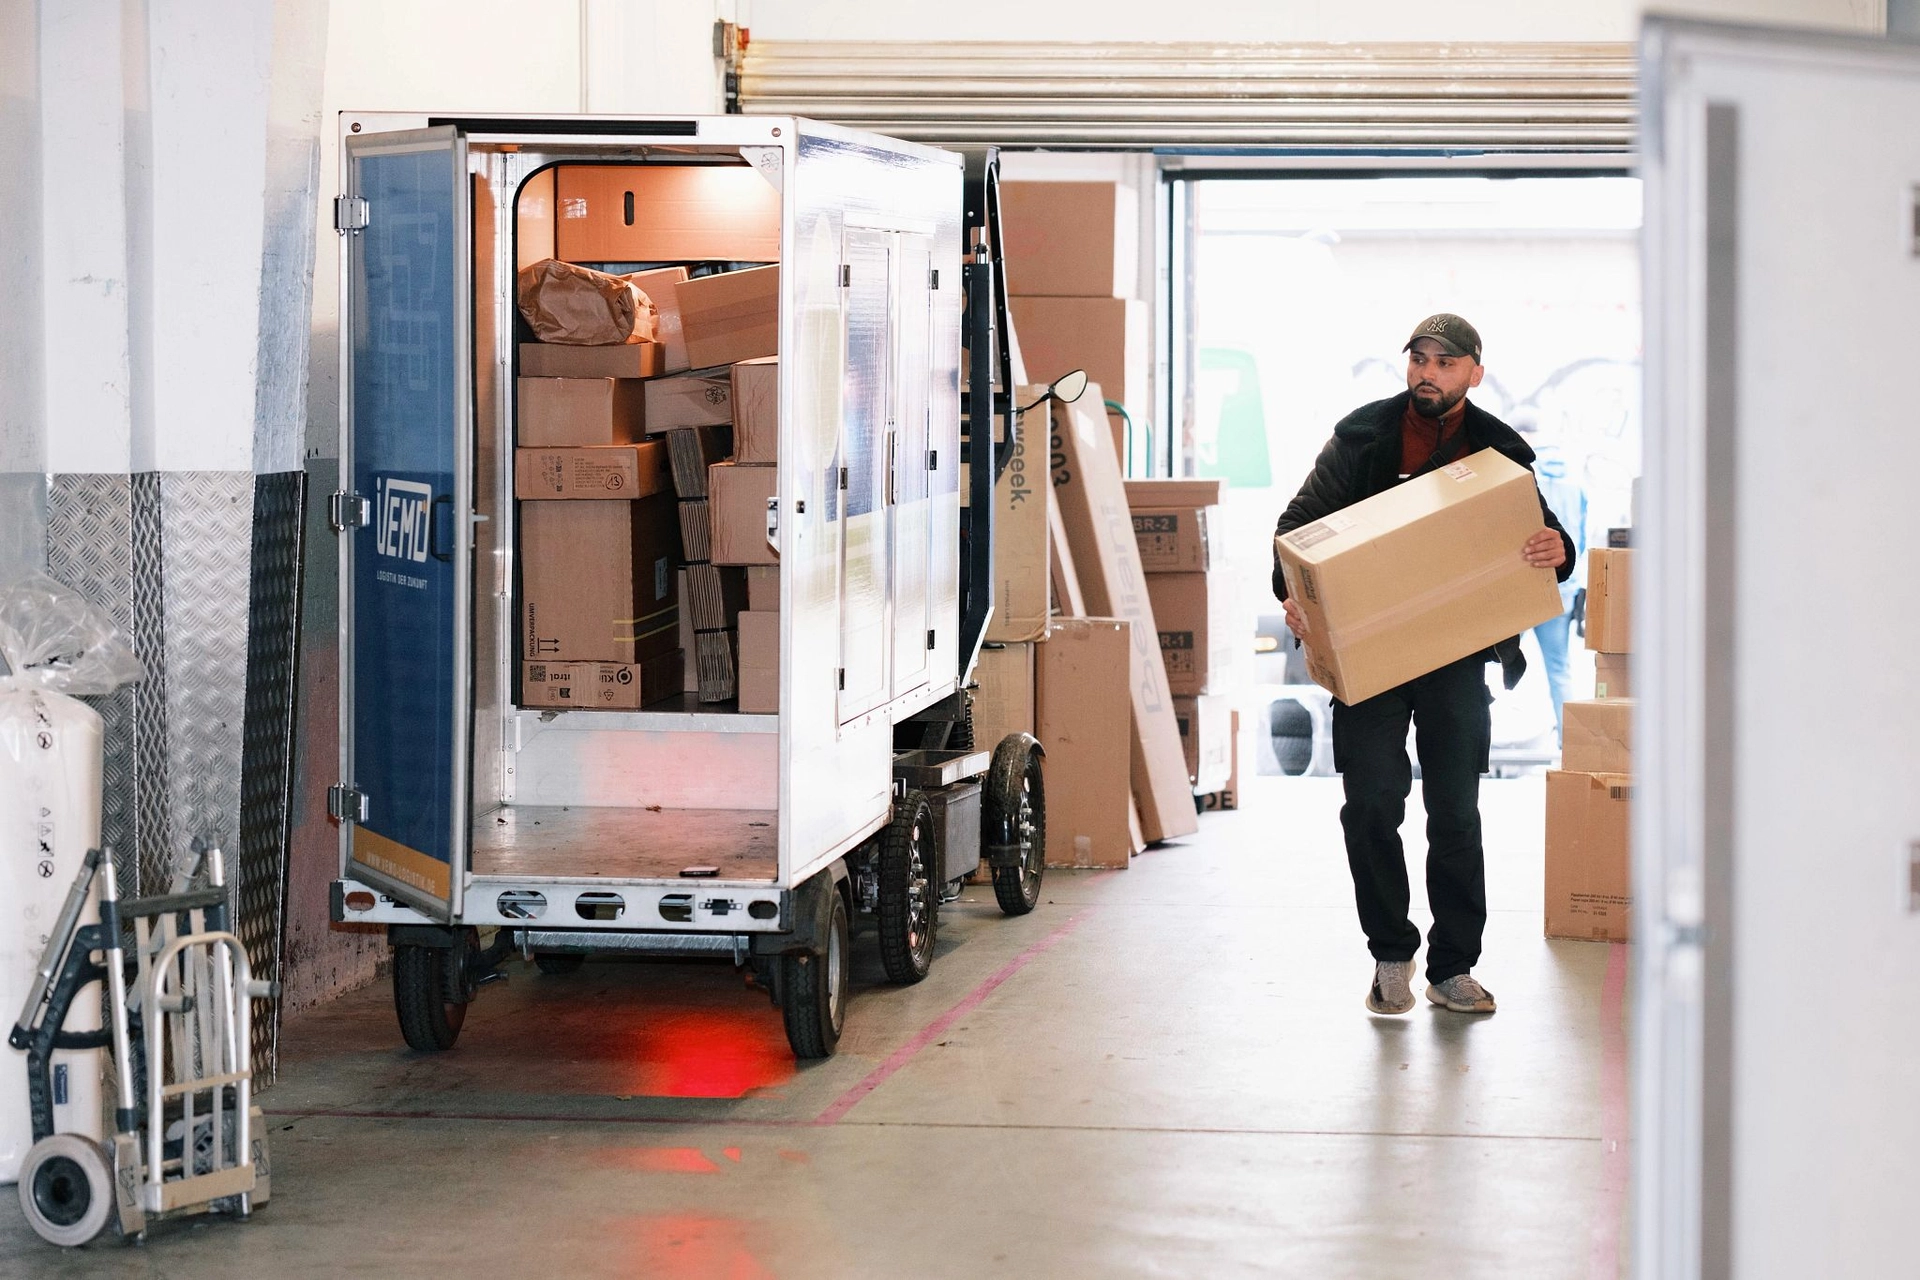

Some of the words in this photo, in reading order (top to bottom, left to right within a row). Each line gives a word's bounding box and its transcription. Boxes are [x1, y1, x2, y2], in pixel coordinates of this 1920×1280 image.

[376, 570, 397, 583] LOGISTIK
[397, 573, 407, 586] DER
[407, 576, 428, 590] ZUKUNFT
[1101, 497, 1162, 714] Beliani
